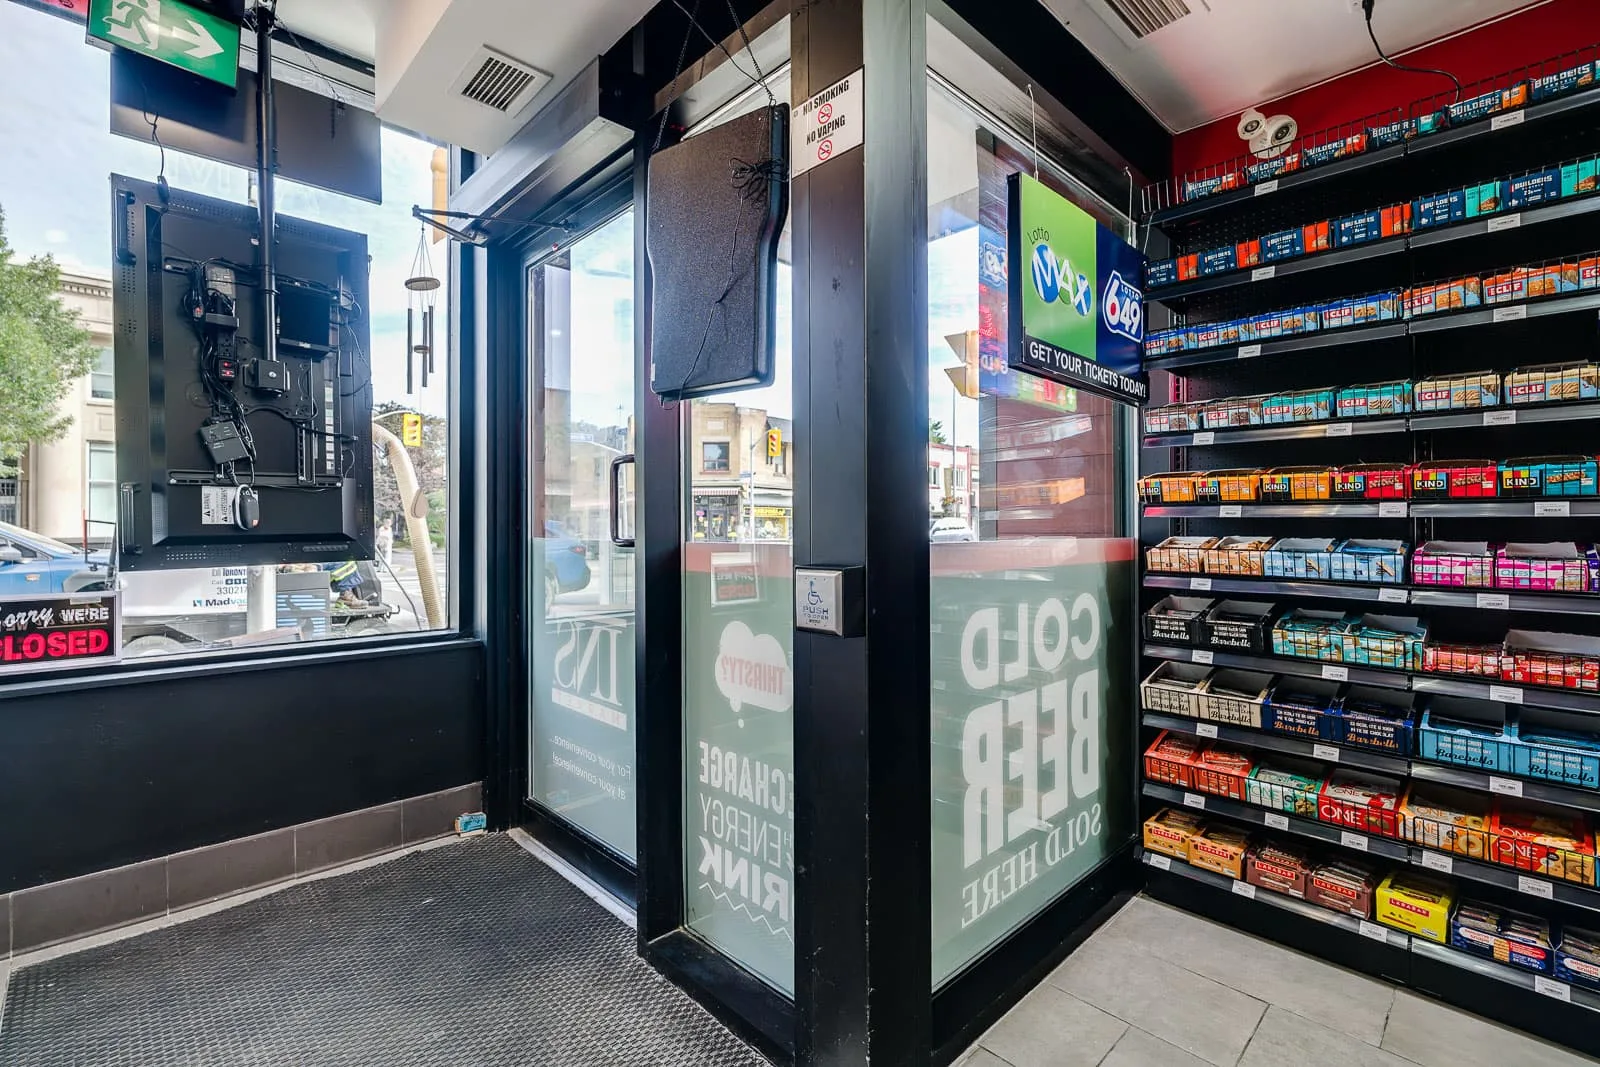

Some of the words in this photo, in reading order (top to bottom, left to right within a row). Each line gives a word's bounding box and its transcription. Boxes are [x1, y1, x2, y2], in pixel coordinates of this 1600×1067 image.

[1534, 62, 1590, 89] BUILDERS
[802, 102, 813, 116] NO
[814, 79, 850, 109] SMOKING
[1450, 94, 1499, 118] BUILDERS
[806, 130, 816, 145] NO
[817, 115, 846, 139] VAPING
[1308, 139, 1344, 156] BUILDERS
[1515, 174, 1553, 190] BUILDERS
[1424, 195, 1459, 210] BUILDERS
[1032, 250, 1091, 316] MAX
[1496, 283, 1522, 295] CLIF
[1121, 284, 1140, 300] LOTTO
[1331, 308, 1351, 318] CLIF
[1029, 341, 1054, 363] GET
[1055, 348, 1083, 375] YOUR
[1084, 362, 1118, 389] TICKETS
[1120, 375, 1147, 398] TODAY!
[1425, 391, 1450, 400] CLIF
[1517, 384, 1545, 395] CLIF
[1344, 399, 1367, 407] CLIF
[1264, 483, 1287, 491] KIND
[1337, 482, 1363, 491] KIND
[1416, 480, 1444, 488] KIND
[1506, 478, 1537, 486] KIND
[1198, 487, 1218, 495] KIND
[0, 606, 53, 630] orry
[60, 606, 110, 622] WE'RE
[803, 605, 829, 615] PUSH
[0, 628, 109, 661] LOSED
[1274, 720, 1319, 736] Barebells
[1436, 748, 1494, 766] Barebells
[1529, 764, 1594, 783] Barebells
[1333, 786, 1360, 797] ONE
[1320, 804, 1363, 826] ONE
[1416, 806, 1450, 819] ONE
[1498, 840, 1539, 861] ONE
